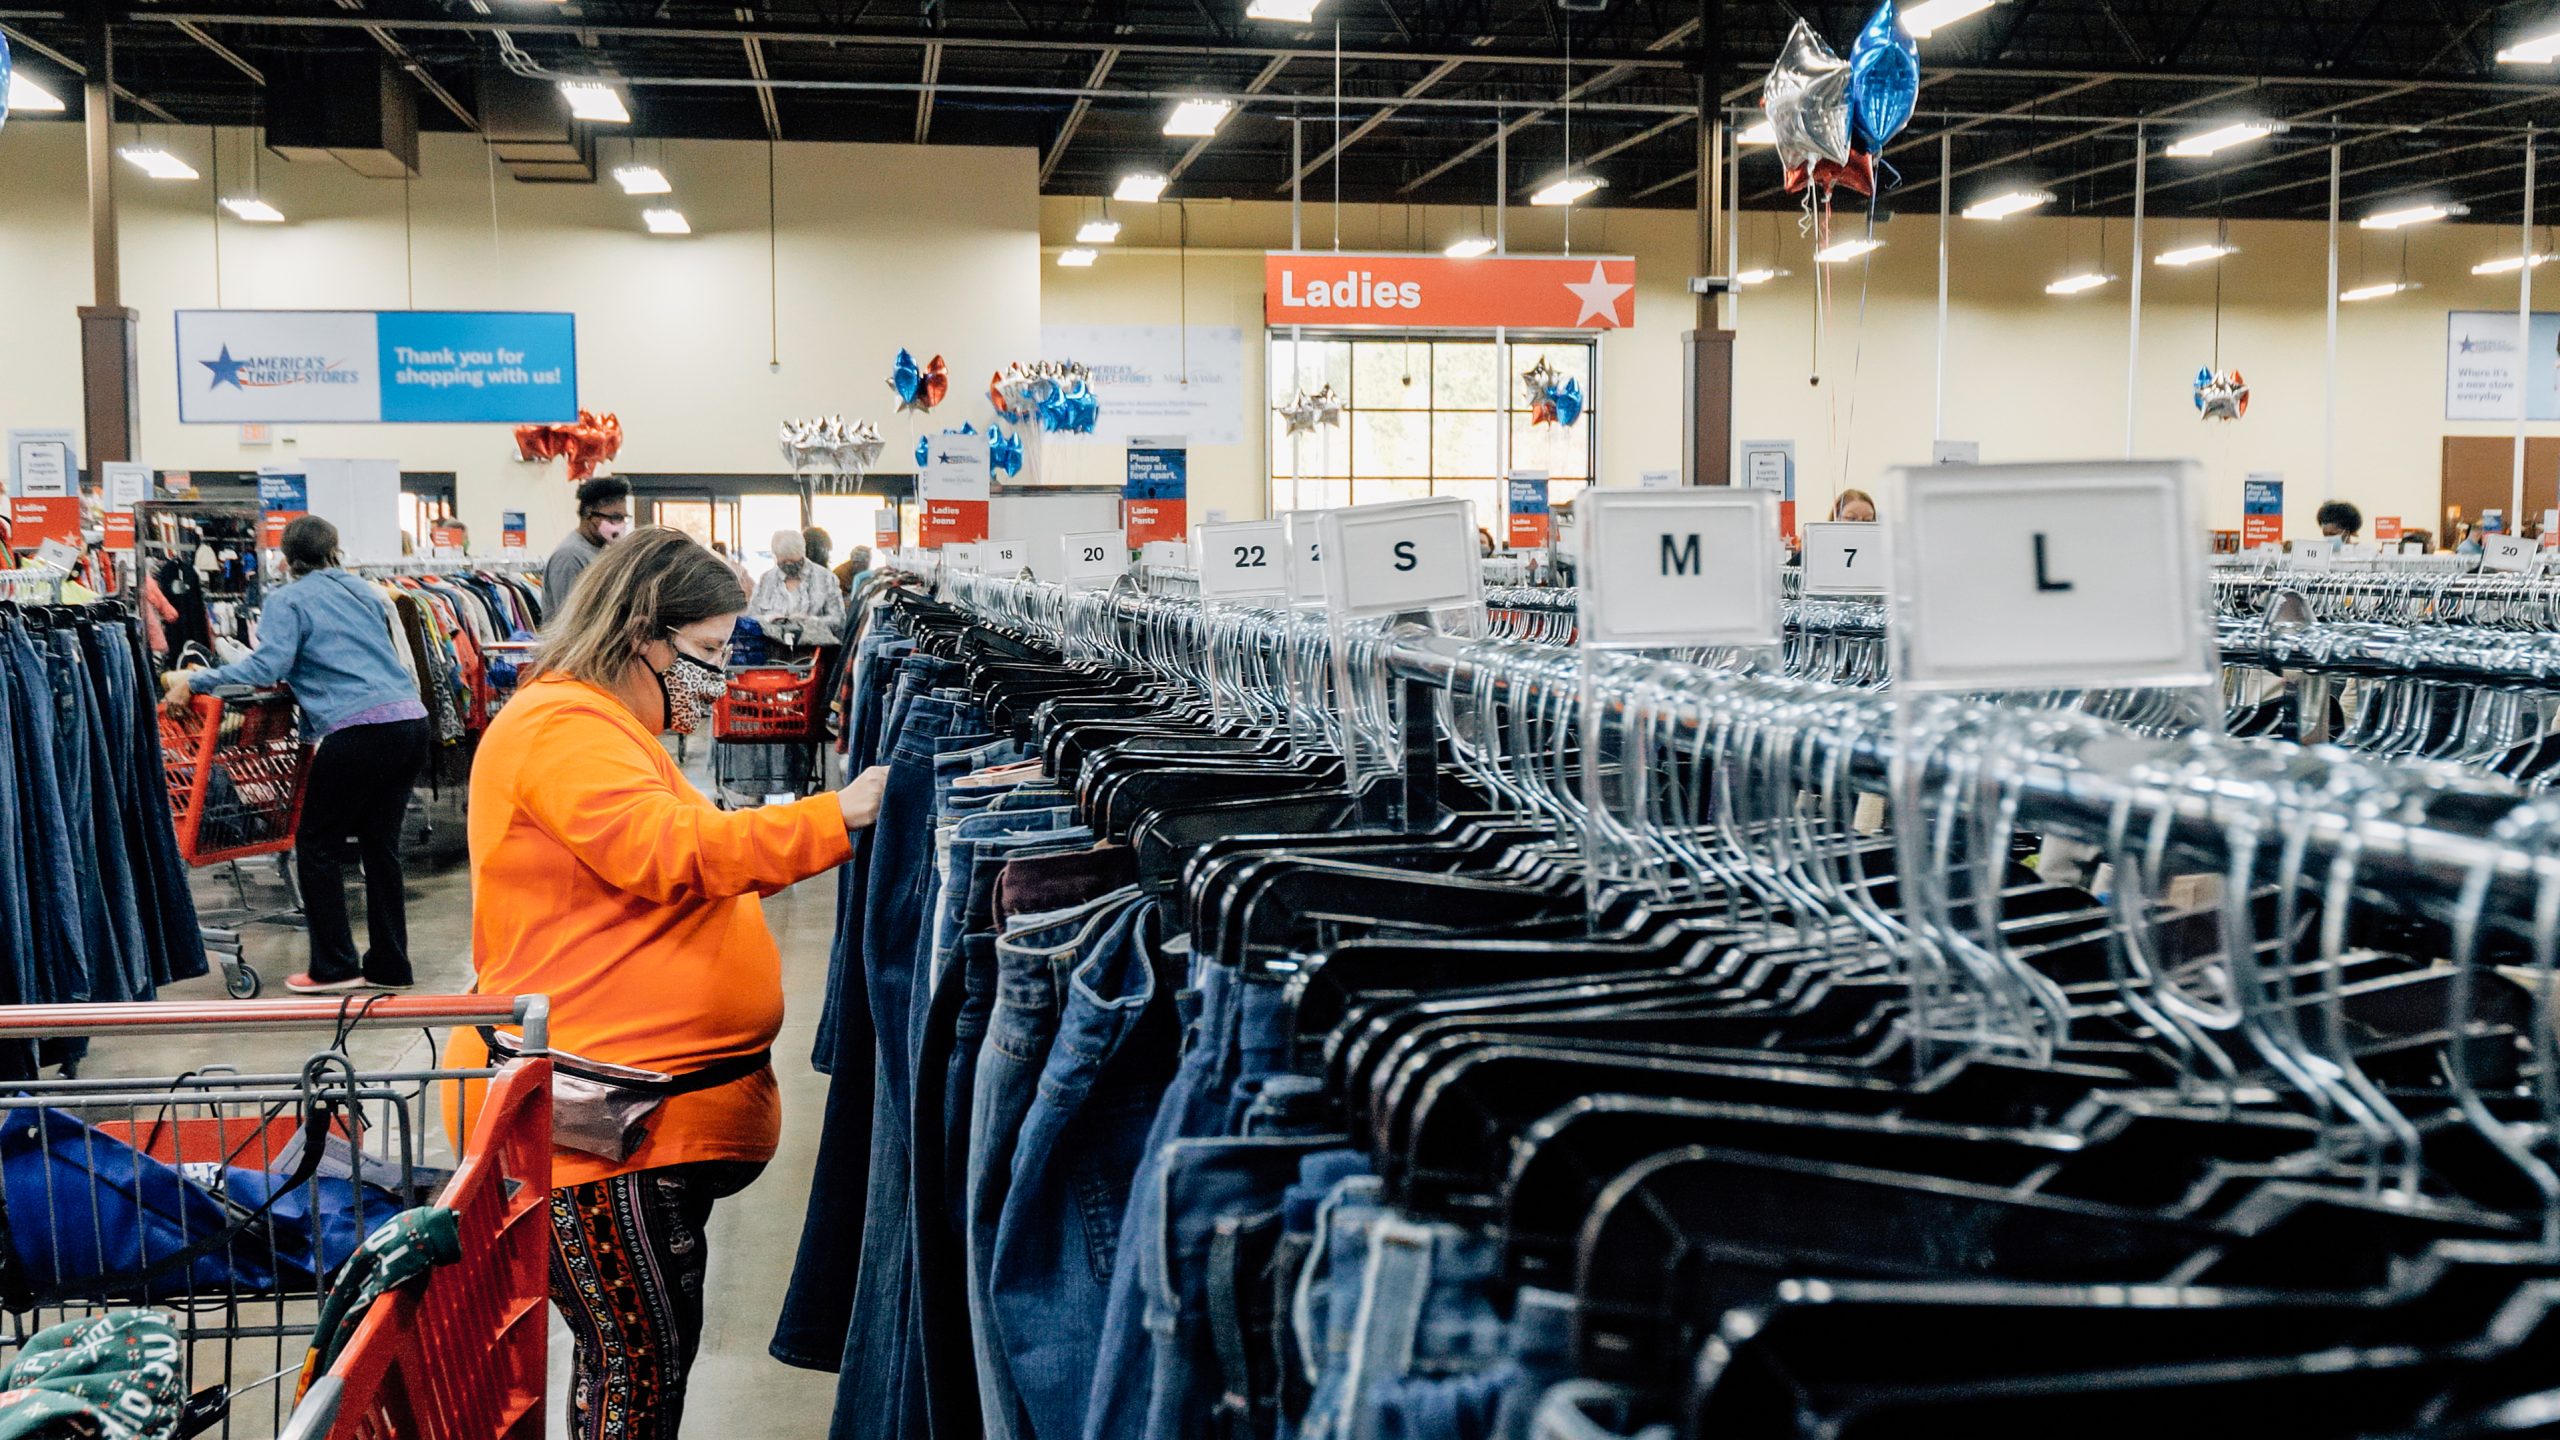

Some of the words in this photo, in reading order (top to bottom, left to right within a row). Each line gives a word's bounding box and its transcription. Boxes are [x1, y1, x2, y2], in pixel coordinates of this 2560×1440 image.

[1281, 270, 1421, 309] Ladies
[394, 346, 455, 365] Thank
[459, 350, 493, 368] you
[497, 347, 525, 365] for
[249, 357, 325, 370] AMERICA'S
[1087, 364, 1133, 375] MERICA'S
[2458, 367, 2491, 378] Where
[2493, 367, 2509, 378] it's
[304, 370, 359, 384] STORES
[396, 367, 484, 388] shopping
[488, 367, 528, 384] with
[532, 367, 561, 384] us!
[2465, 381, 2487, 389] new
[2488, 380, 2515, 389] store
[1129, 453, 1161, 463] Please
[1129, 462, 1153, 472] shop
[1154, 462, 1168, 471] six
[1129, 471, 1149, 480] feet
[1149, 471, 1177, 481] apart.
[931, 506, 960, 515] Ladies
[1131, 506, 1159, 515] Ladies
[931, 516, 957, 525] Jeans
[1131, 516, 1156, 525] Pants
[959, 552, 969, 560] 16
[1000, 549, 1013, 560] 18
[1084, 547, 1104, 561] 20
[1234, 545, 1267, 568] 22
[1393, 540, 1417, 571] S
[1660, 534, 1700, 576] M
[2306, 549, 2318, 558] 18
[2501, 546, 2518, 557] 20
[1844, 548, 1857, 568] 7
[2032, 532, 2073, 591] L
